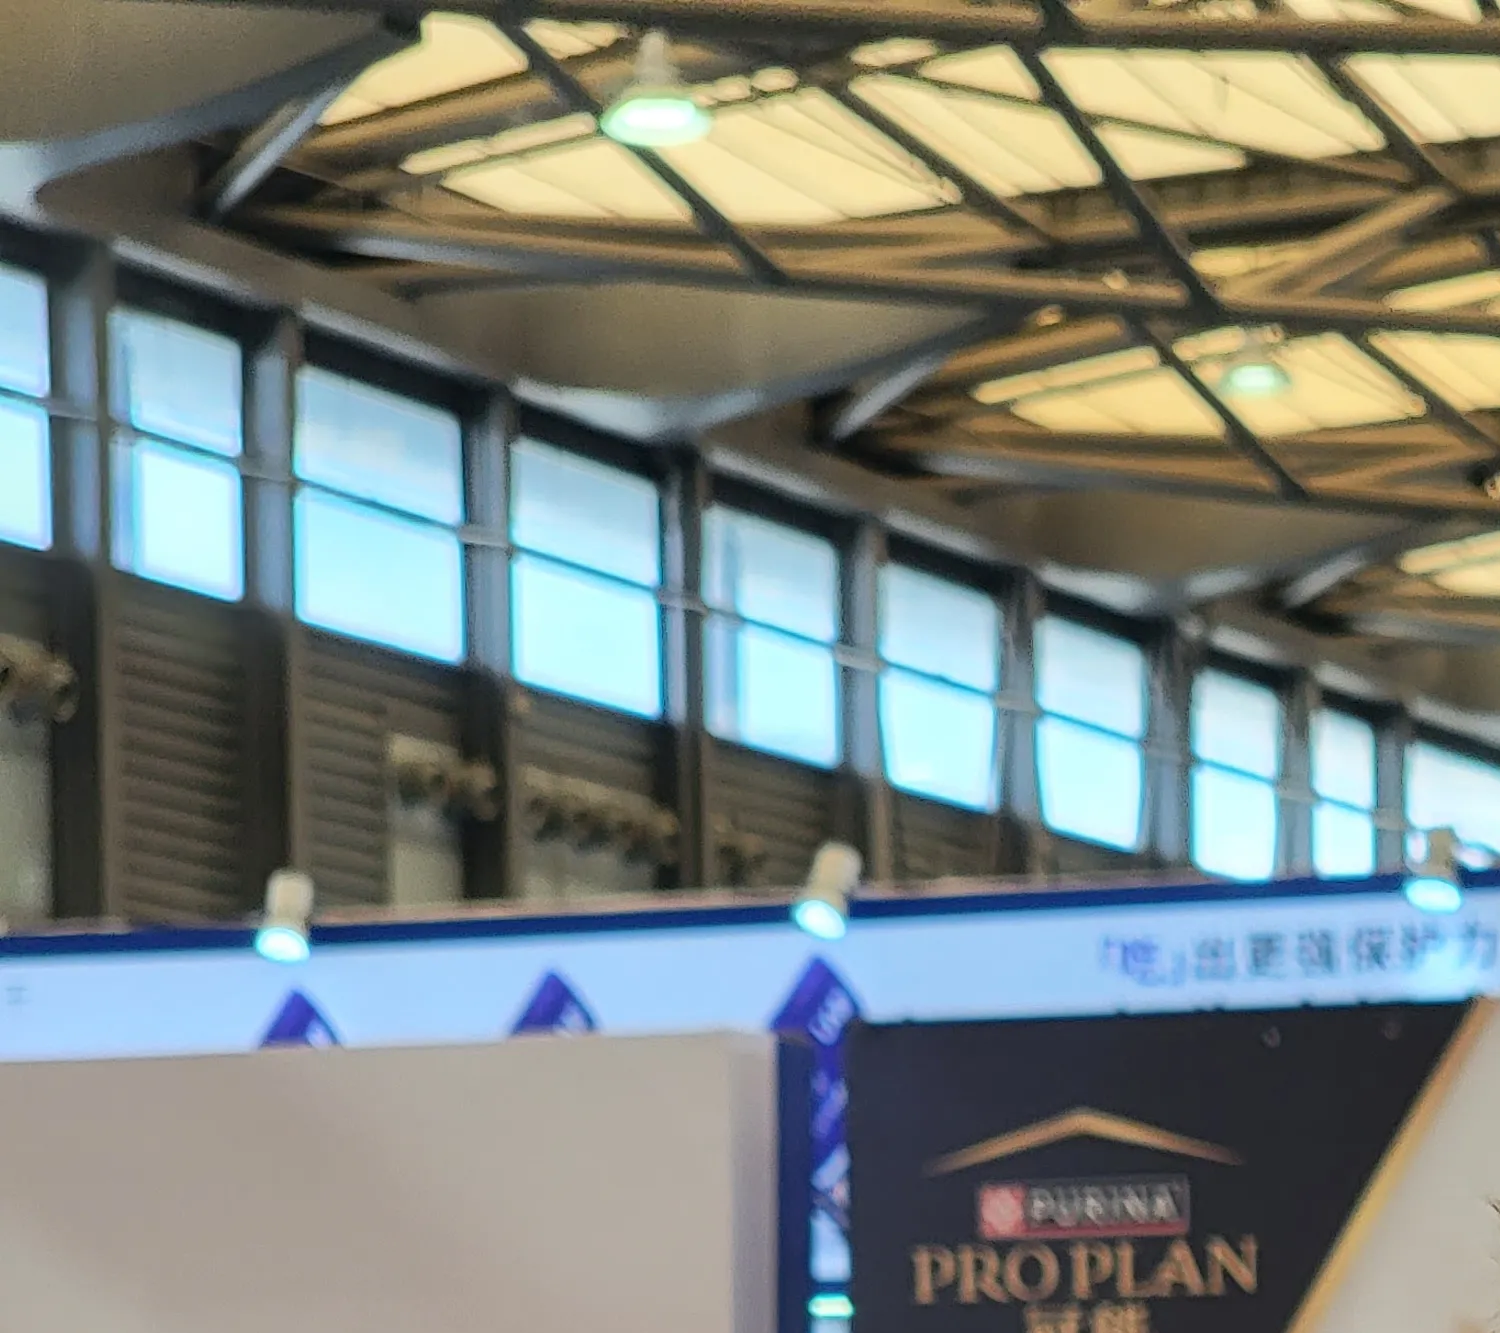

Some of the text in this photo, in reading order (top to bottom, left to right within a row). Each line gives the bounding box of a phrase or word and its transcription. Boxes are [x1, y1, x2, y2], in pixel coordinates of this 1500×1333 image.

[1028, 1183, 1178, 1227] PURINA
[912, 1234, 1258, 1304] PRO PLAN
